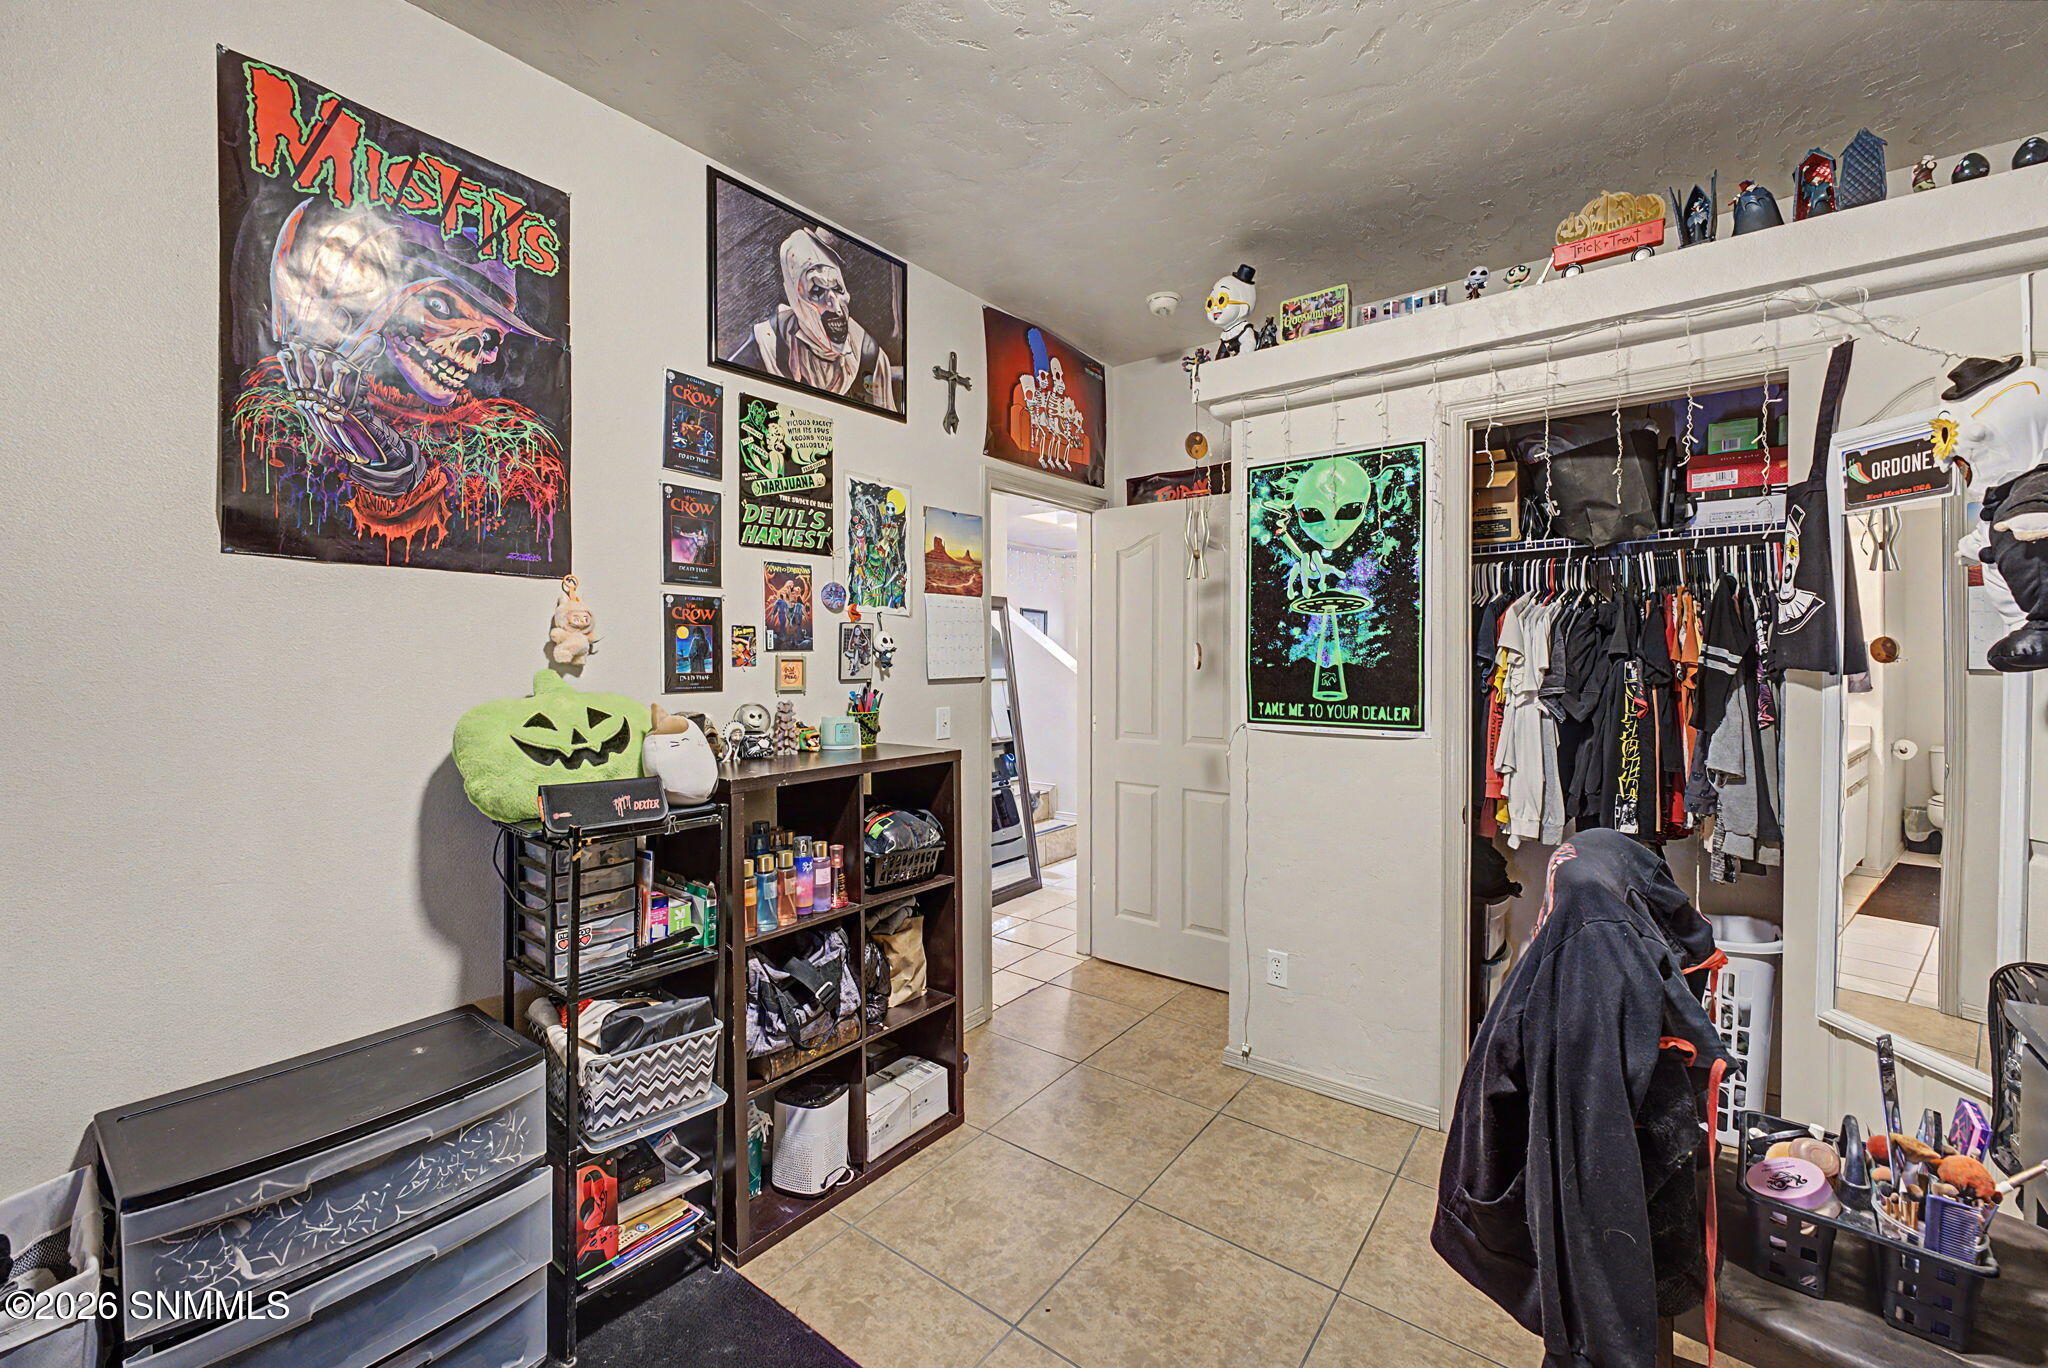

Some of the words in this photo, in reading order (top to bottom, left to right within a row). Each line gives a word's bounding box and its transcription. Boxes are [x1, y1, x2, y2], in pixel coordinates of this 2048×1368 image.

[242, 60, 561, 278] MISFITS
[672, 384, 719, 408] CROW
[786, 419, 811, 427] VICIOUS
[1871, 450, 1940, 480] ORDONE
[760, 475, 815, 494] MARIJUANA
[671, 497, 715, 518] CROW
[672, 606, 717, 624] CROW
[1257, 702, 1285, 716] TAKE
[1288, 703, 1305, 717] ME
[1308, 704, 1323, 719] TO
[1327, 705, 1359, 719] YOUR
[1362, 705, 1411, 721] DEALER
[633, 798, 660, 811] DEXTER
